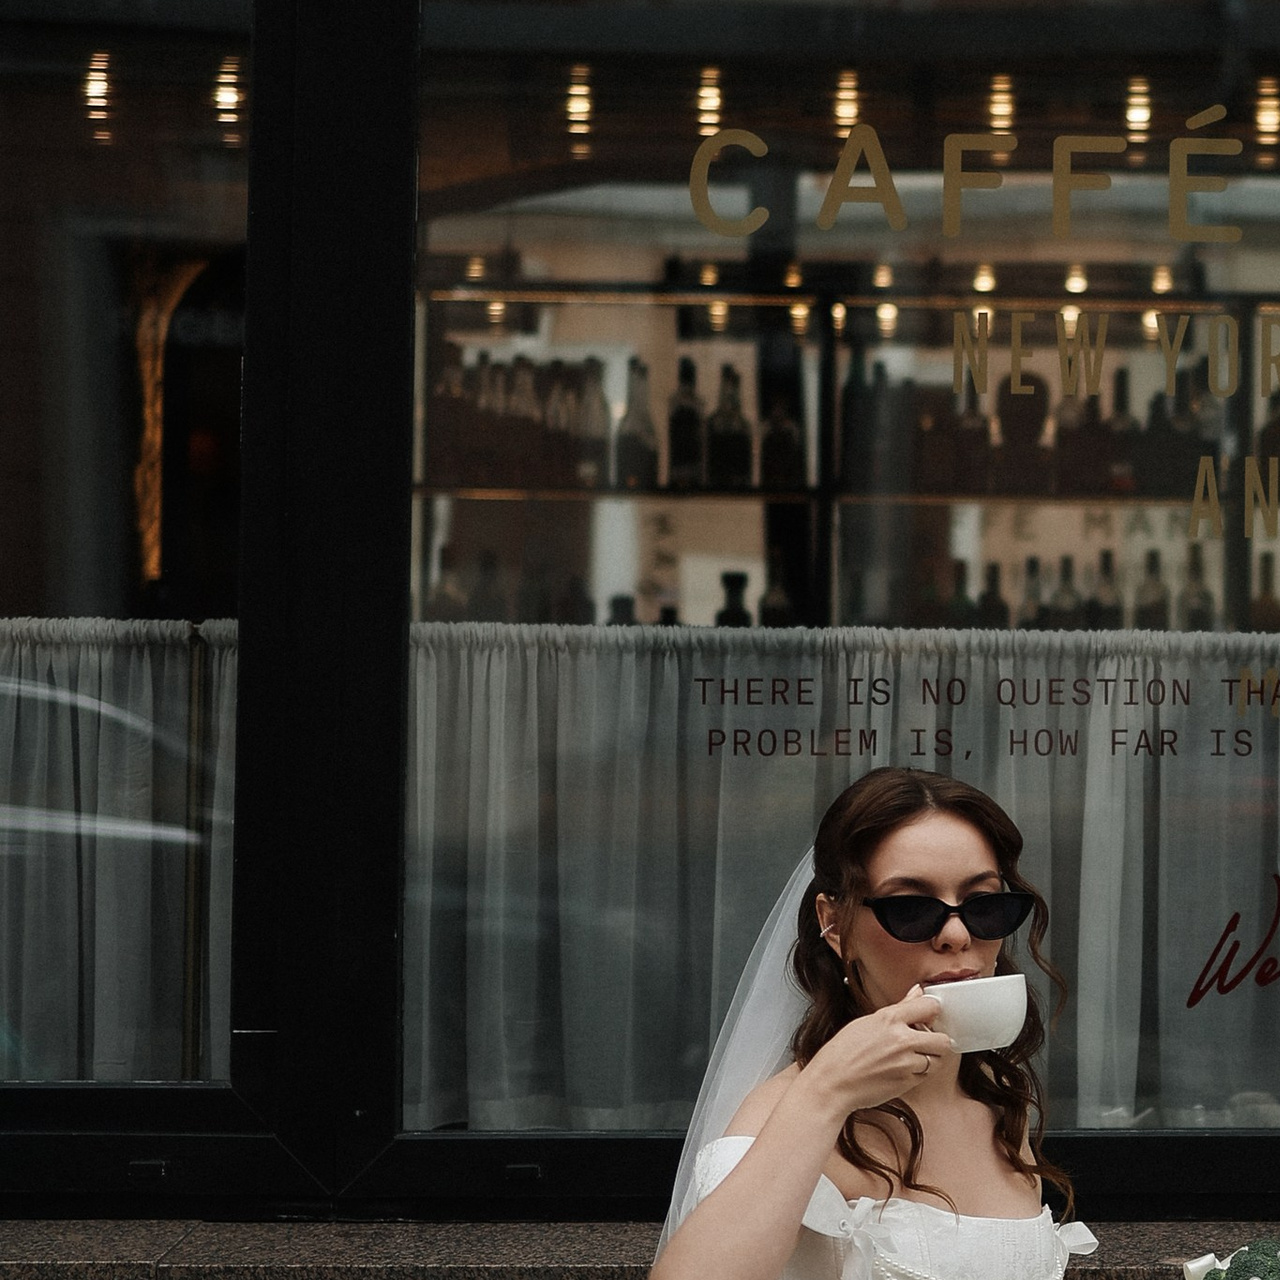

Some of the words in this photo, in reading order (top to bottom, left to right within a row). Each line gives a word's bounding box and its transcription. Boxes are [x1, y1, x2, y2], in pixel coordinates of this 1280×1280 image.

[689, 104, 1243, 243] CAFFÉ
[952, 311, 1109, 397] NEW
[694, 676, 816, 706] THERE
[848, 676, 892, 706] IS
[921, 677, 967, 706] NO
[995, 677, 1192, 708] QUESTION
[708, 728, 879, 757] PROBLEM
[909, 728, 975, 761] IS,
[1009, 728, 1080, 757] HOW
[1110, 729, 1178, 757] FAR
[1209, 729, 1254, 757] IS
